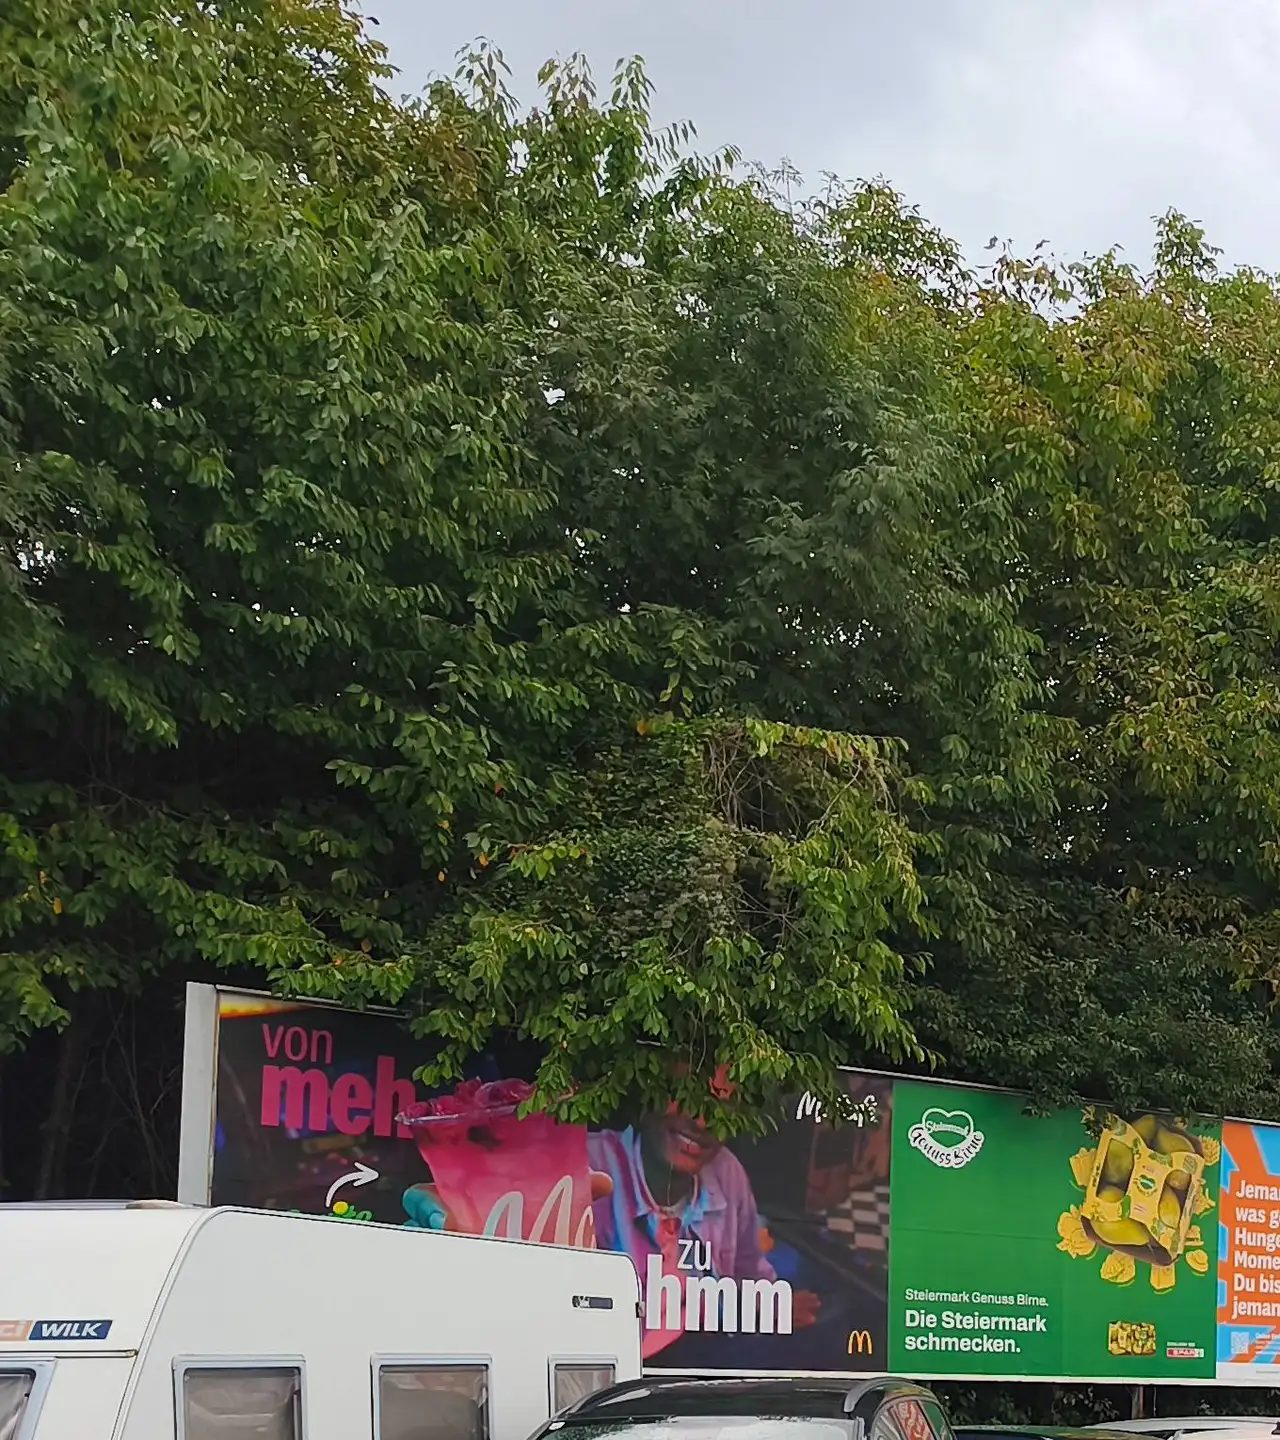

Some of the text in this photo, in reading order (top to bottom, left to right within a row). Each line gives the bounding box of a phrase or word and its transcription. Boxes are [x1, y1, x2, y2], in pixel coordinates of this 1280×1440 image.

[262, 1023, 333, 1064] von
[1236, 1207, 1266, 1223] was
[678, 1239, 711, 1271] zu
[1233, 1273, 1256, 1292] Du
[646, 1253, 793, 1335] hmm
[905, 1288, 970, 1303] Steiermark
[972, 1291, 1015, 1305] Genuss
[42, 1323, 102, 1337] WILK
[905, 1309, 1047, 1332] Die Steiermark
[904, 1332, 1021, 1353] schmecken.
